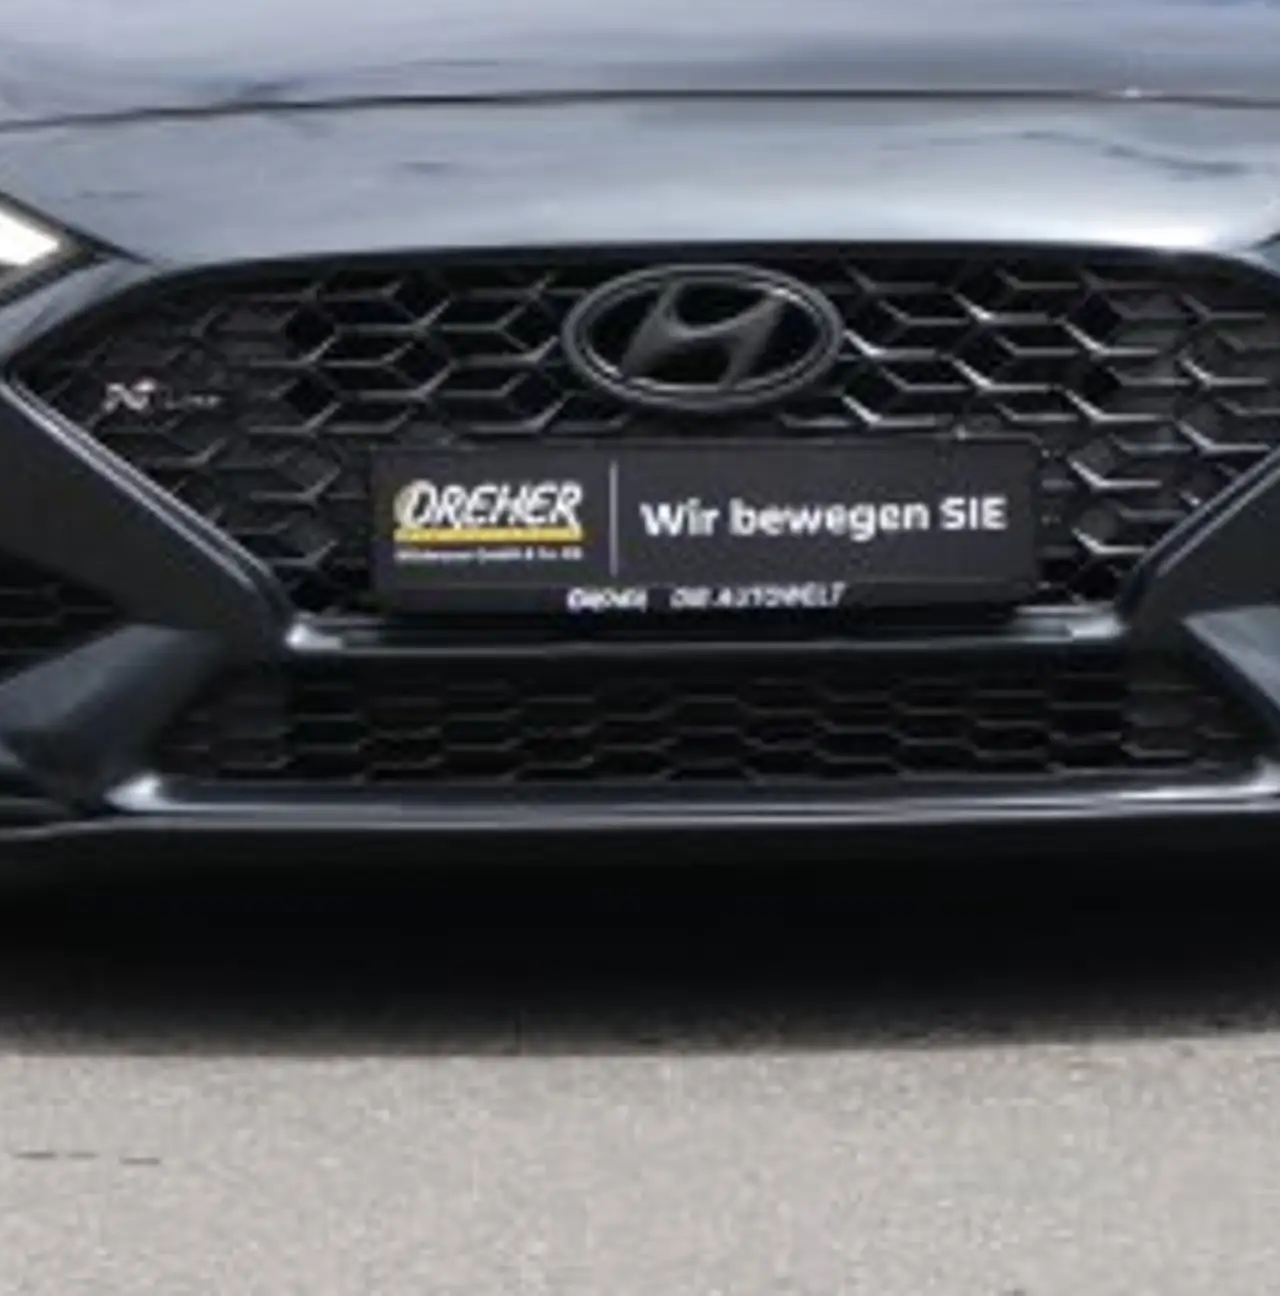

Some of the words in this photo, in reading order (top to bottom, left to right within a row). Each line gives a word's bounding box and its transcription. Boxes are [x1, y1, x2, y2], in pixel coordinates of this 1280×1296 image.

[394, 480, 583, 538] DREHER
[639, 499, 719, 536] Wir
[728, 498, 931, 543] bewegen
[939, 496, 1009, 531] SIE
